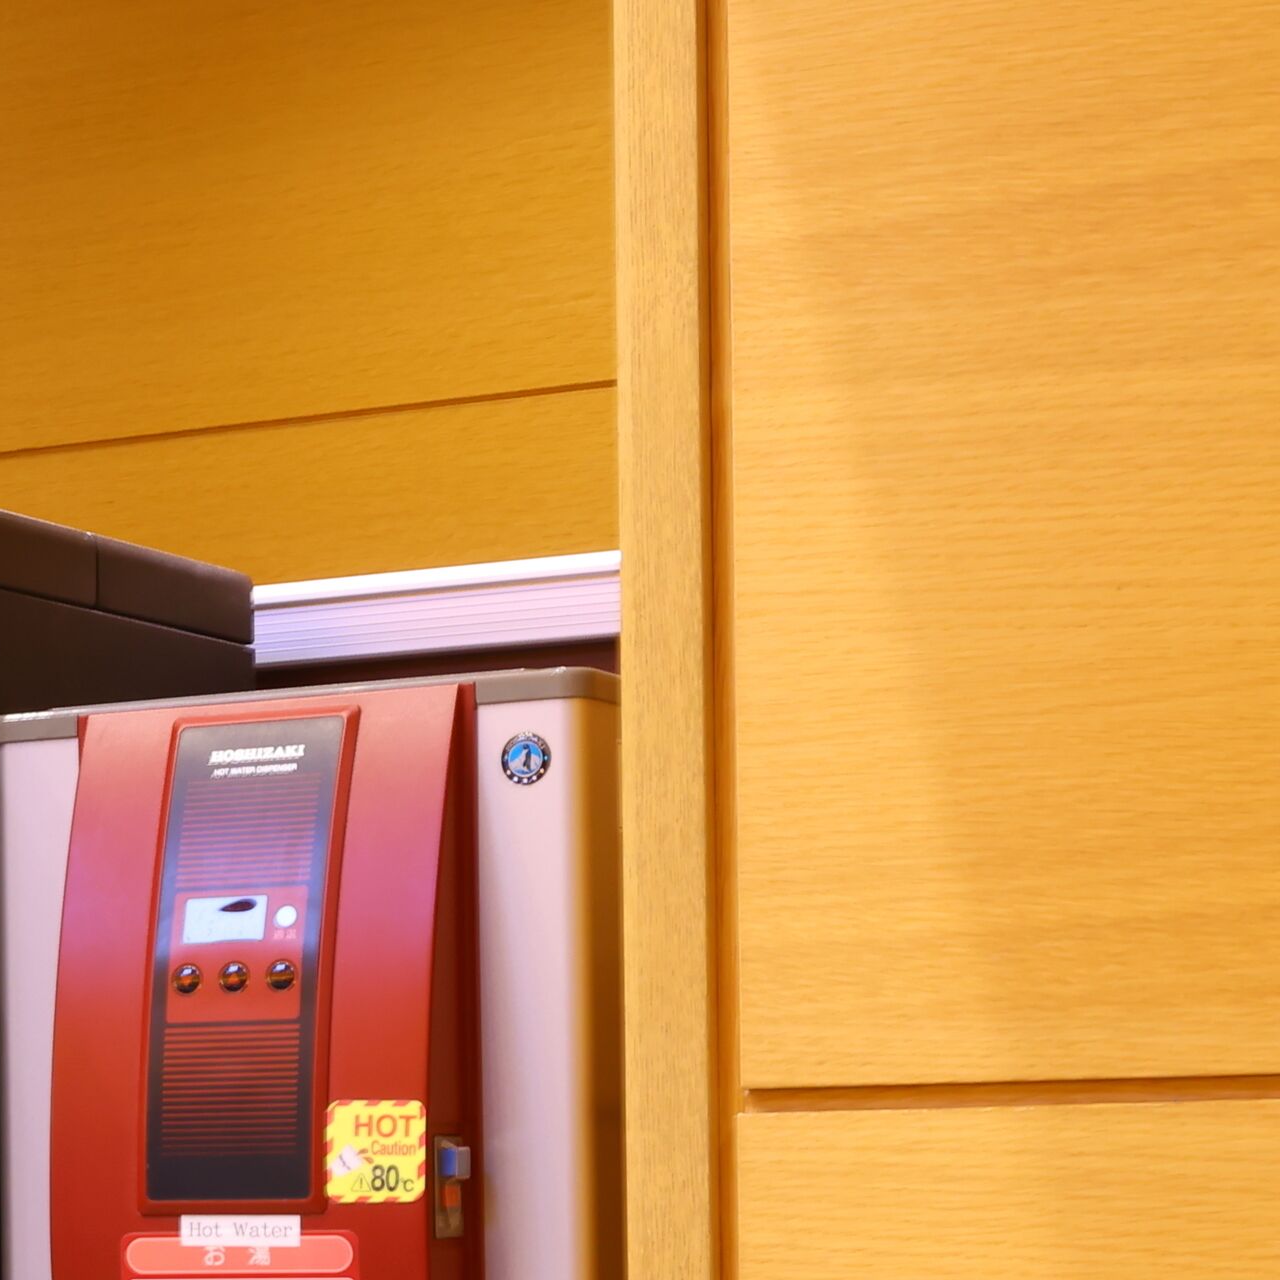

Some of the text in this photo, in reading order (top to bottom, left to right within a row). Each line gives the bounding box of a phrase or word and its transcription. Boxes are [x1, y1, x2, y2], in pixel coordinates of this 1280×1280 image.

[209, 744, 305, 764] HOSHIZAKI
[355, 1114, 417, 1138] HOT
[371, 1140, 416, 1156] Caution
[189, 1222, 293, 1238] Hot Water
